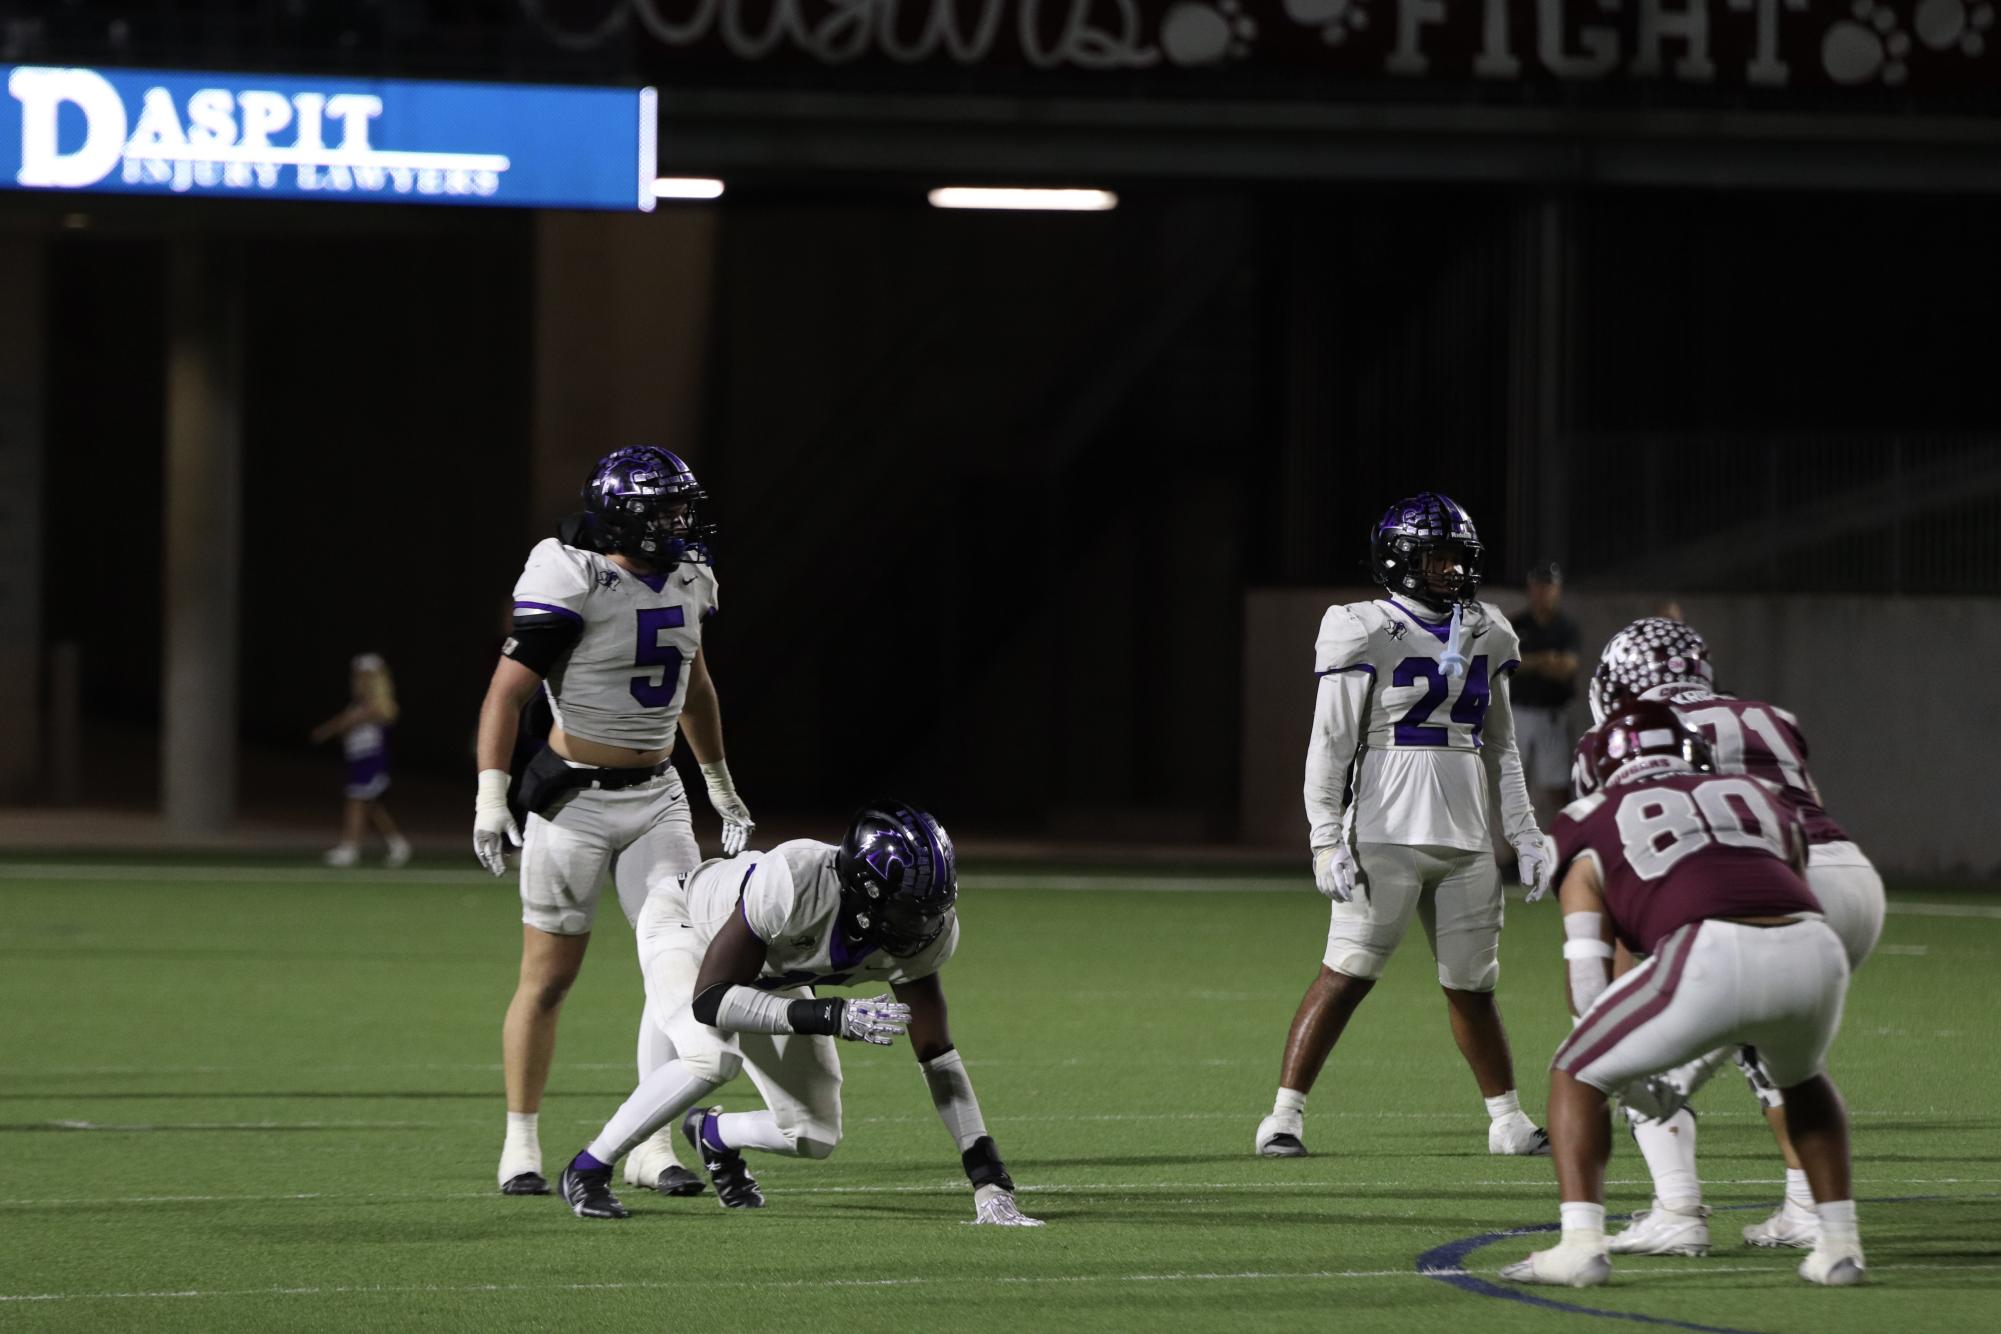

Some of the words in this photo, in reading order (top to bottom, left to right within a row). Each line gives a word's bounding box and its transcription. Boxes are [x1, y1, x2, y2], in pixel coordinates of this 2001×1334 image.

[630, 605, 685, 708] 5
[1392, 654, 1490, 748] 24
[1671, 706, 1808, 791] 71
[1615, 778, 1790, 881] 80
